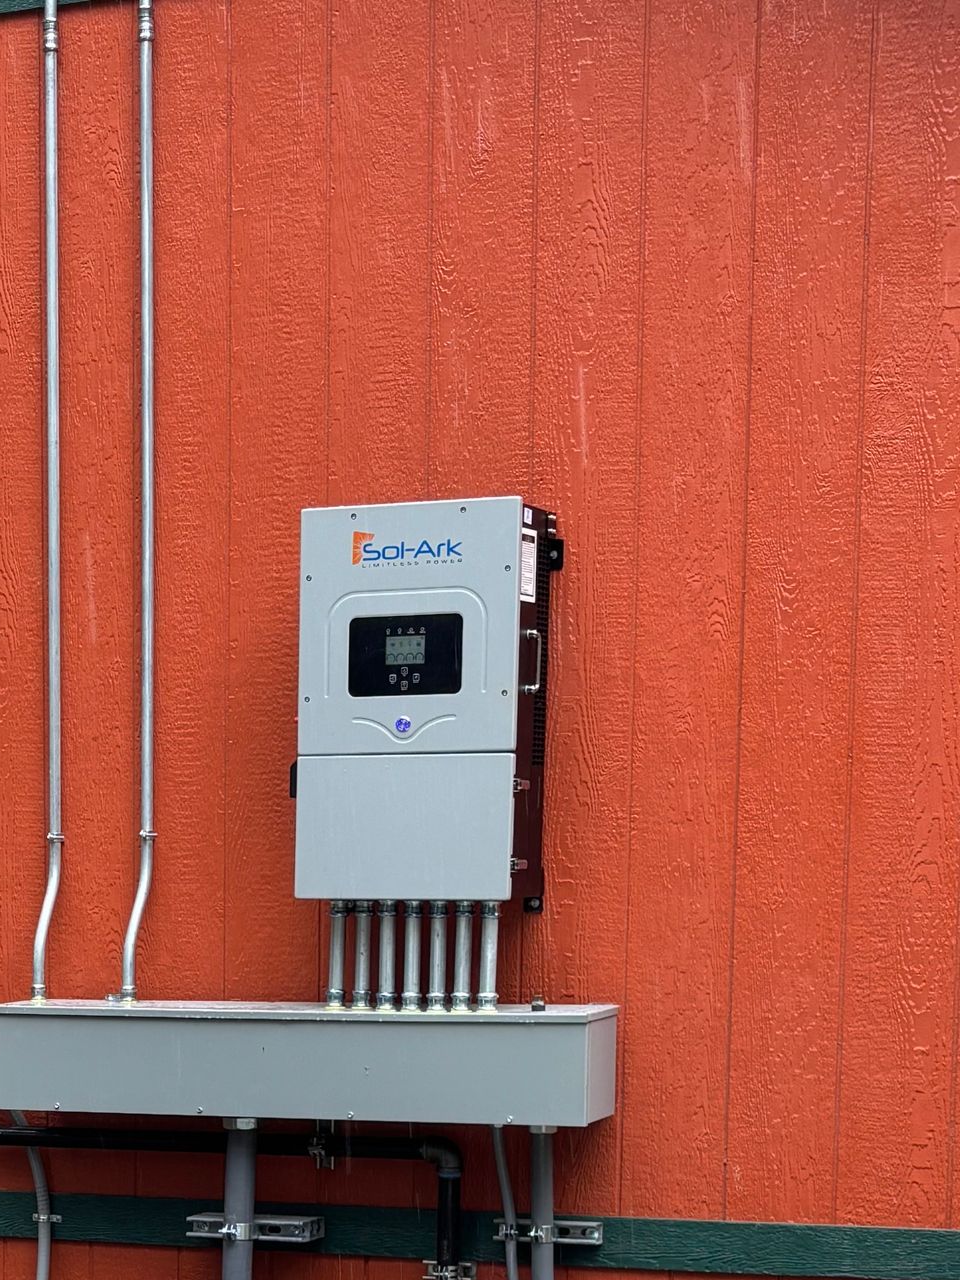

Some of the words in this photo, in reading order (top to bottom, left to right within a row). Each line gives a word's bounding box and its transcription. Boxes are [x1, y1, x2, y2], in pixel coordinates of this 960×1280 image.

[363, 538, 463, 561] Sol-Ark
[362, 560, 419, 569] LIMITLESS
[426, 558, 463, 566] POWER
